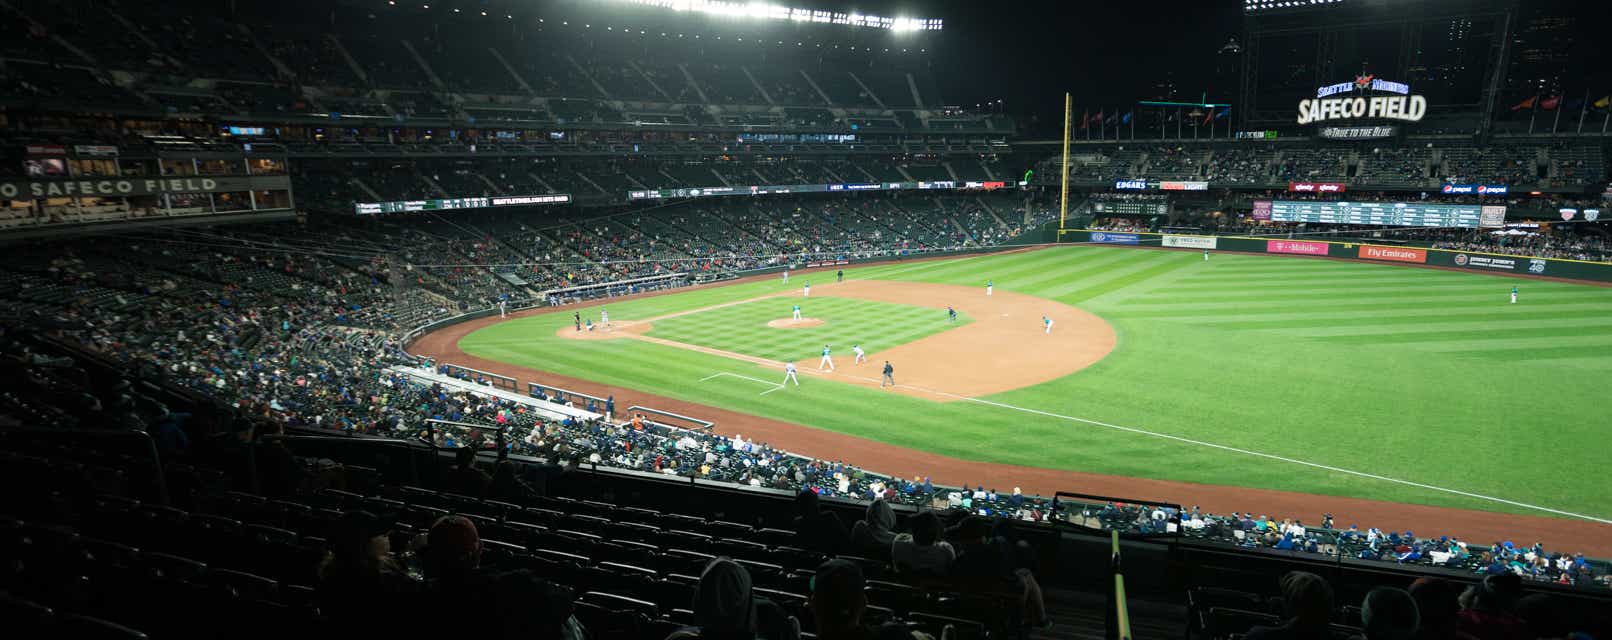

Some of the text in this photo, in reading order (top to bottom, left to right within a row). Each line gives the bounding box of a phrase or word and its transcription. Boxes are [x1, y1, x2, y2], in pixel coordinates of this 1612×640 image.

[1317, 82, 1353, 98] SEATTLE
[1297, 95, 1427, 125] SAFECO FIELD
[1331, 126, 1392, 137] TRUE TO THE BLUE
[31, 180, 132, 197] SAFECO
[145, 178, 217, 191] FIELD
[1453, 186, 1472, 194] pepsi
[1487, 186, 1506, 194] pepsi
[1368, 248, 1417, 259] Fly Emirates
